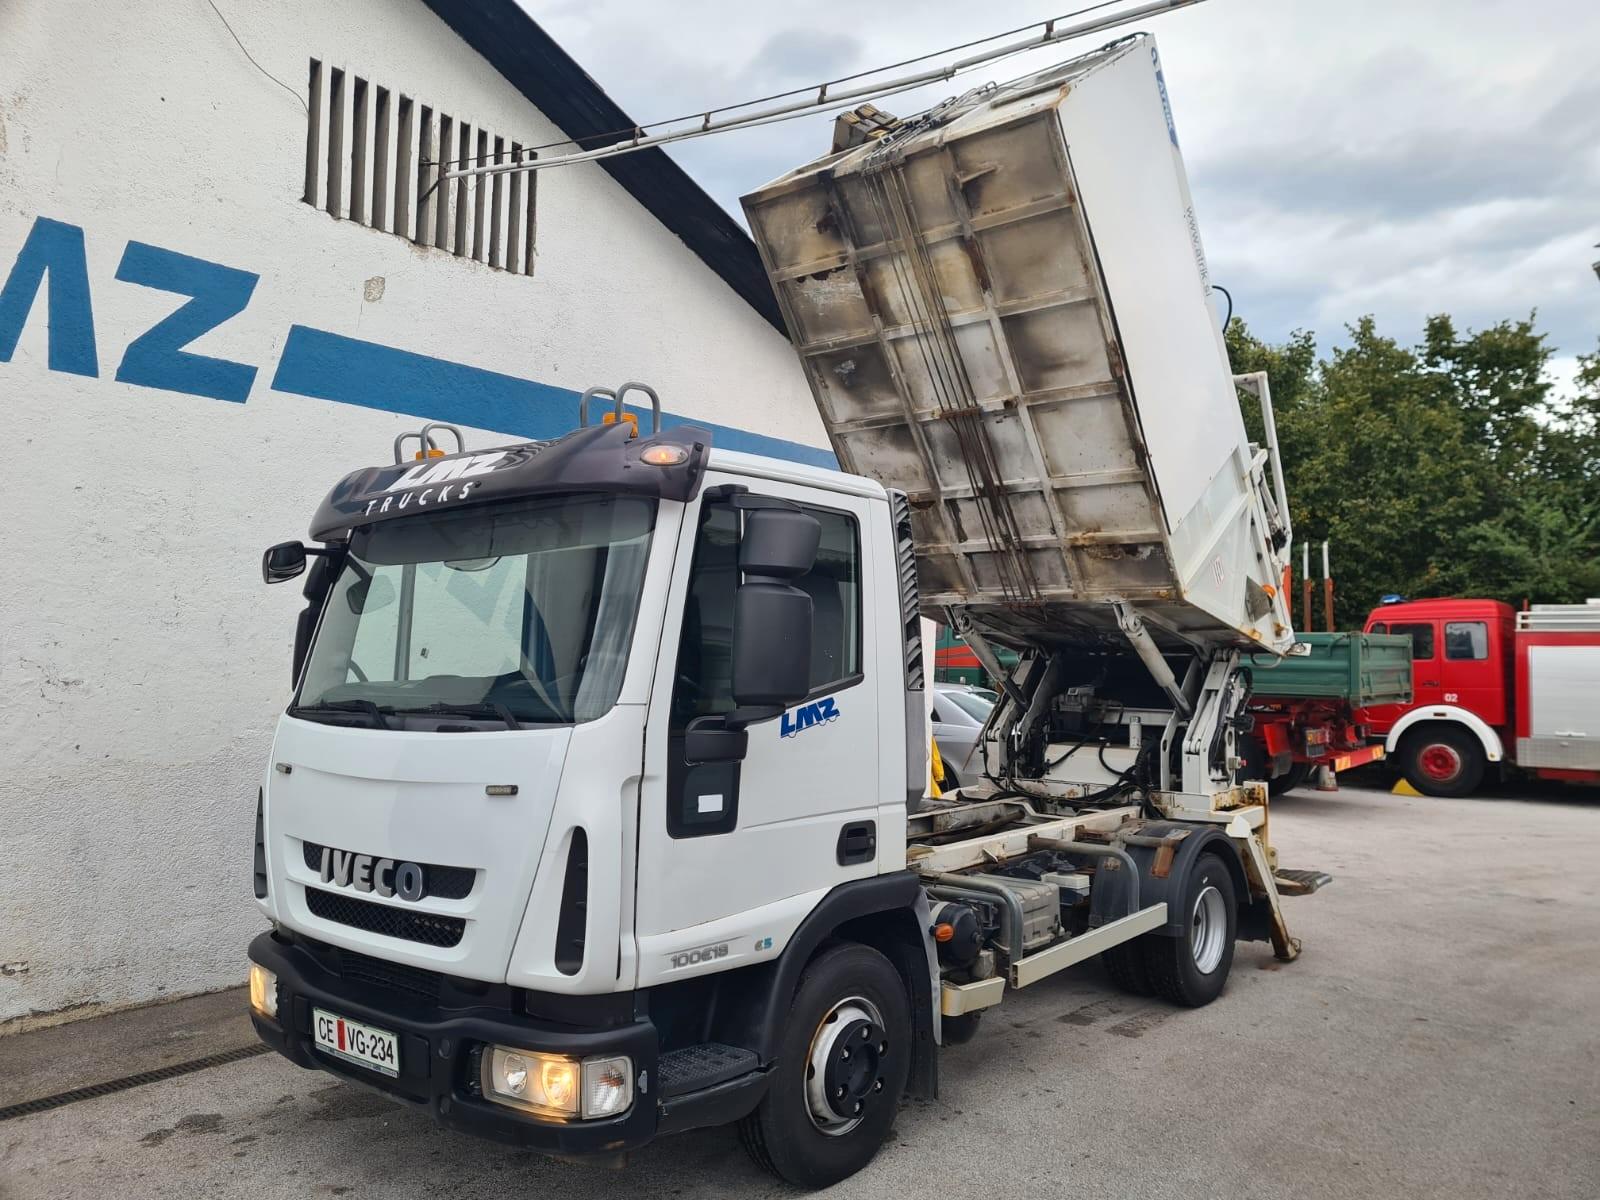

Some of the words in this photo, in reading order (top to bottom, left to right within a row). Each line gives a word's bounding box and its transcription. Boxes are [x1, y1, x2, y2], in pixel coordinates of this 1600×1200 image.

[384, 451, 509, 492] LMZ
[364, 481, 474, 516] TRUCKS
[780, 697, 840, 737] LMZ
[1444, 693, 1459, 703] 02
[320, 847, 426, 902] IVECO
[318, 1016, 334, 1043] CE
[347, 1026, 394, 1064] VG-234
